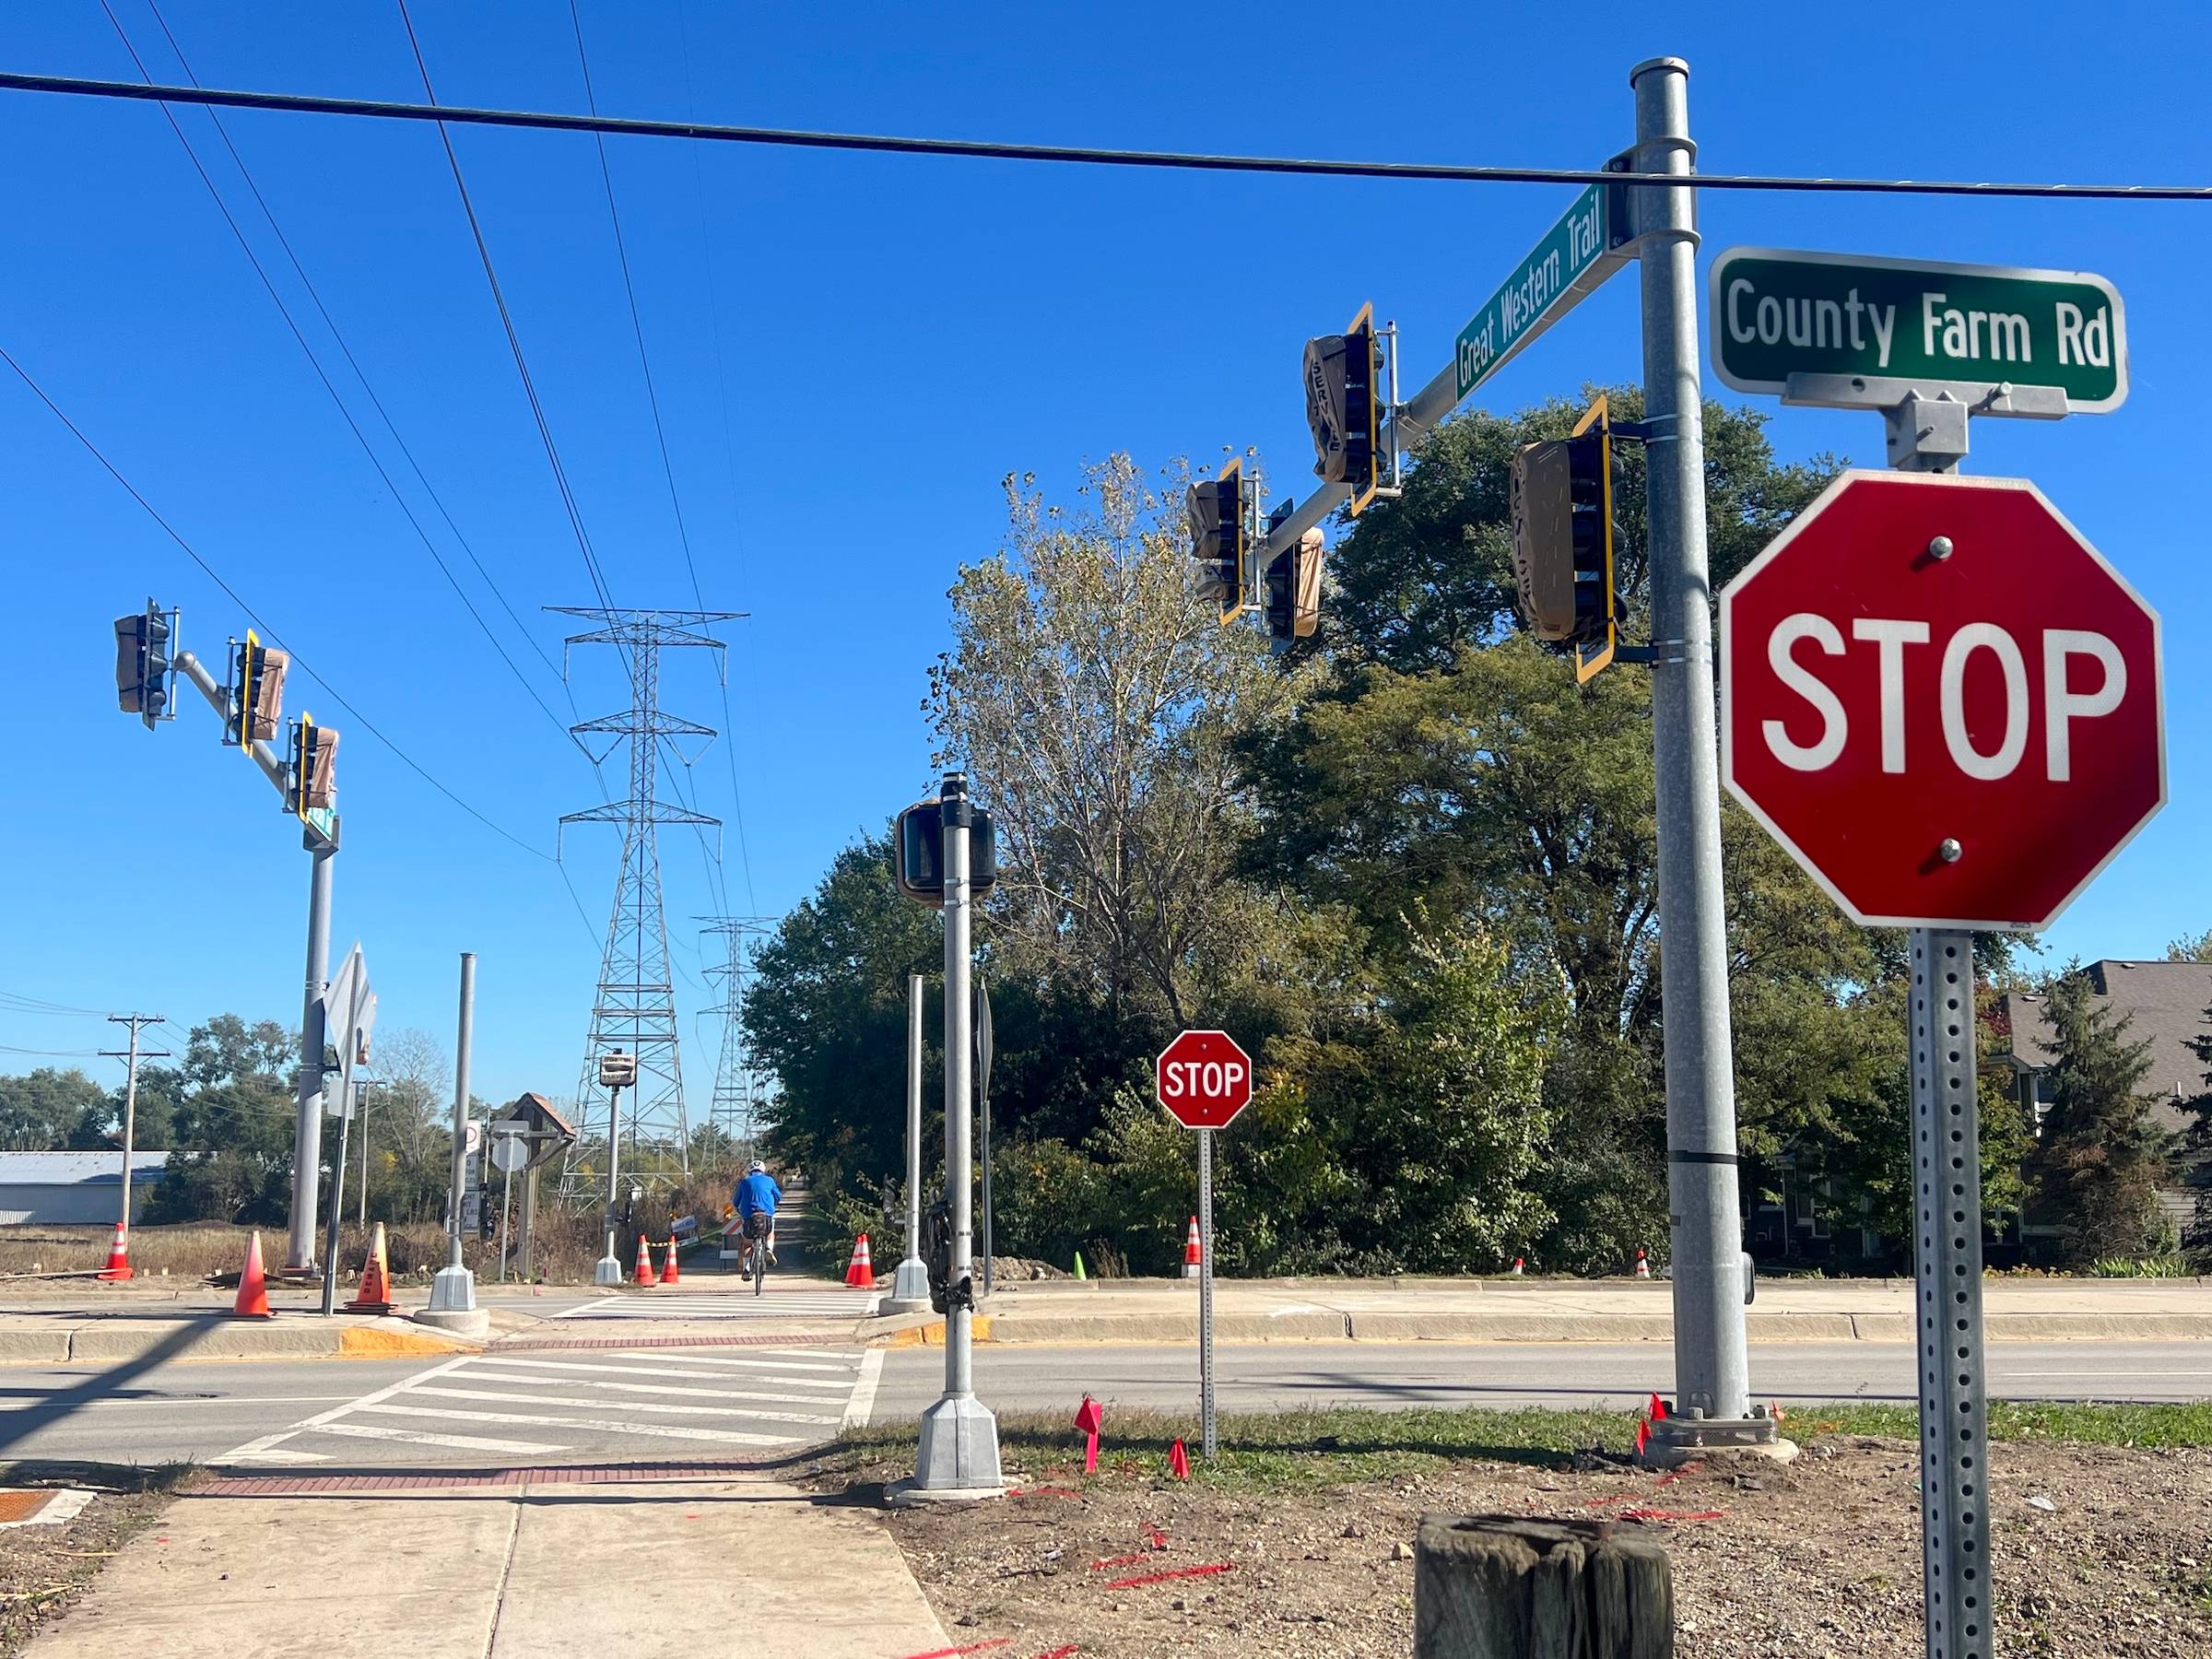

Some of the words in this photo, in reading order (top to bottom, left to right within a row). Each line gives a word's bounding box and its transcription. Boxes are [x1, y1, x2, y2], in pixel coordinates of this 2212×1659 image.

[1460, 310, 1495, 387] Great
[1500, 248, 1560, 344] Western
[1567, 189, 1601, 272] Trail
[1727, 277, 1896, 368] County
[1922, 292, 2032, 362] Farm
[2055, 301, 2111, 368] Rd
[1761, 612, 2127, 782] STOP
[1165, 1061, 1244, 1098] STOP
